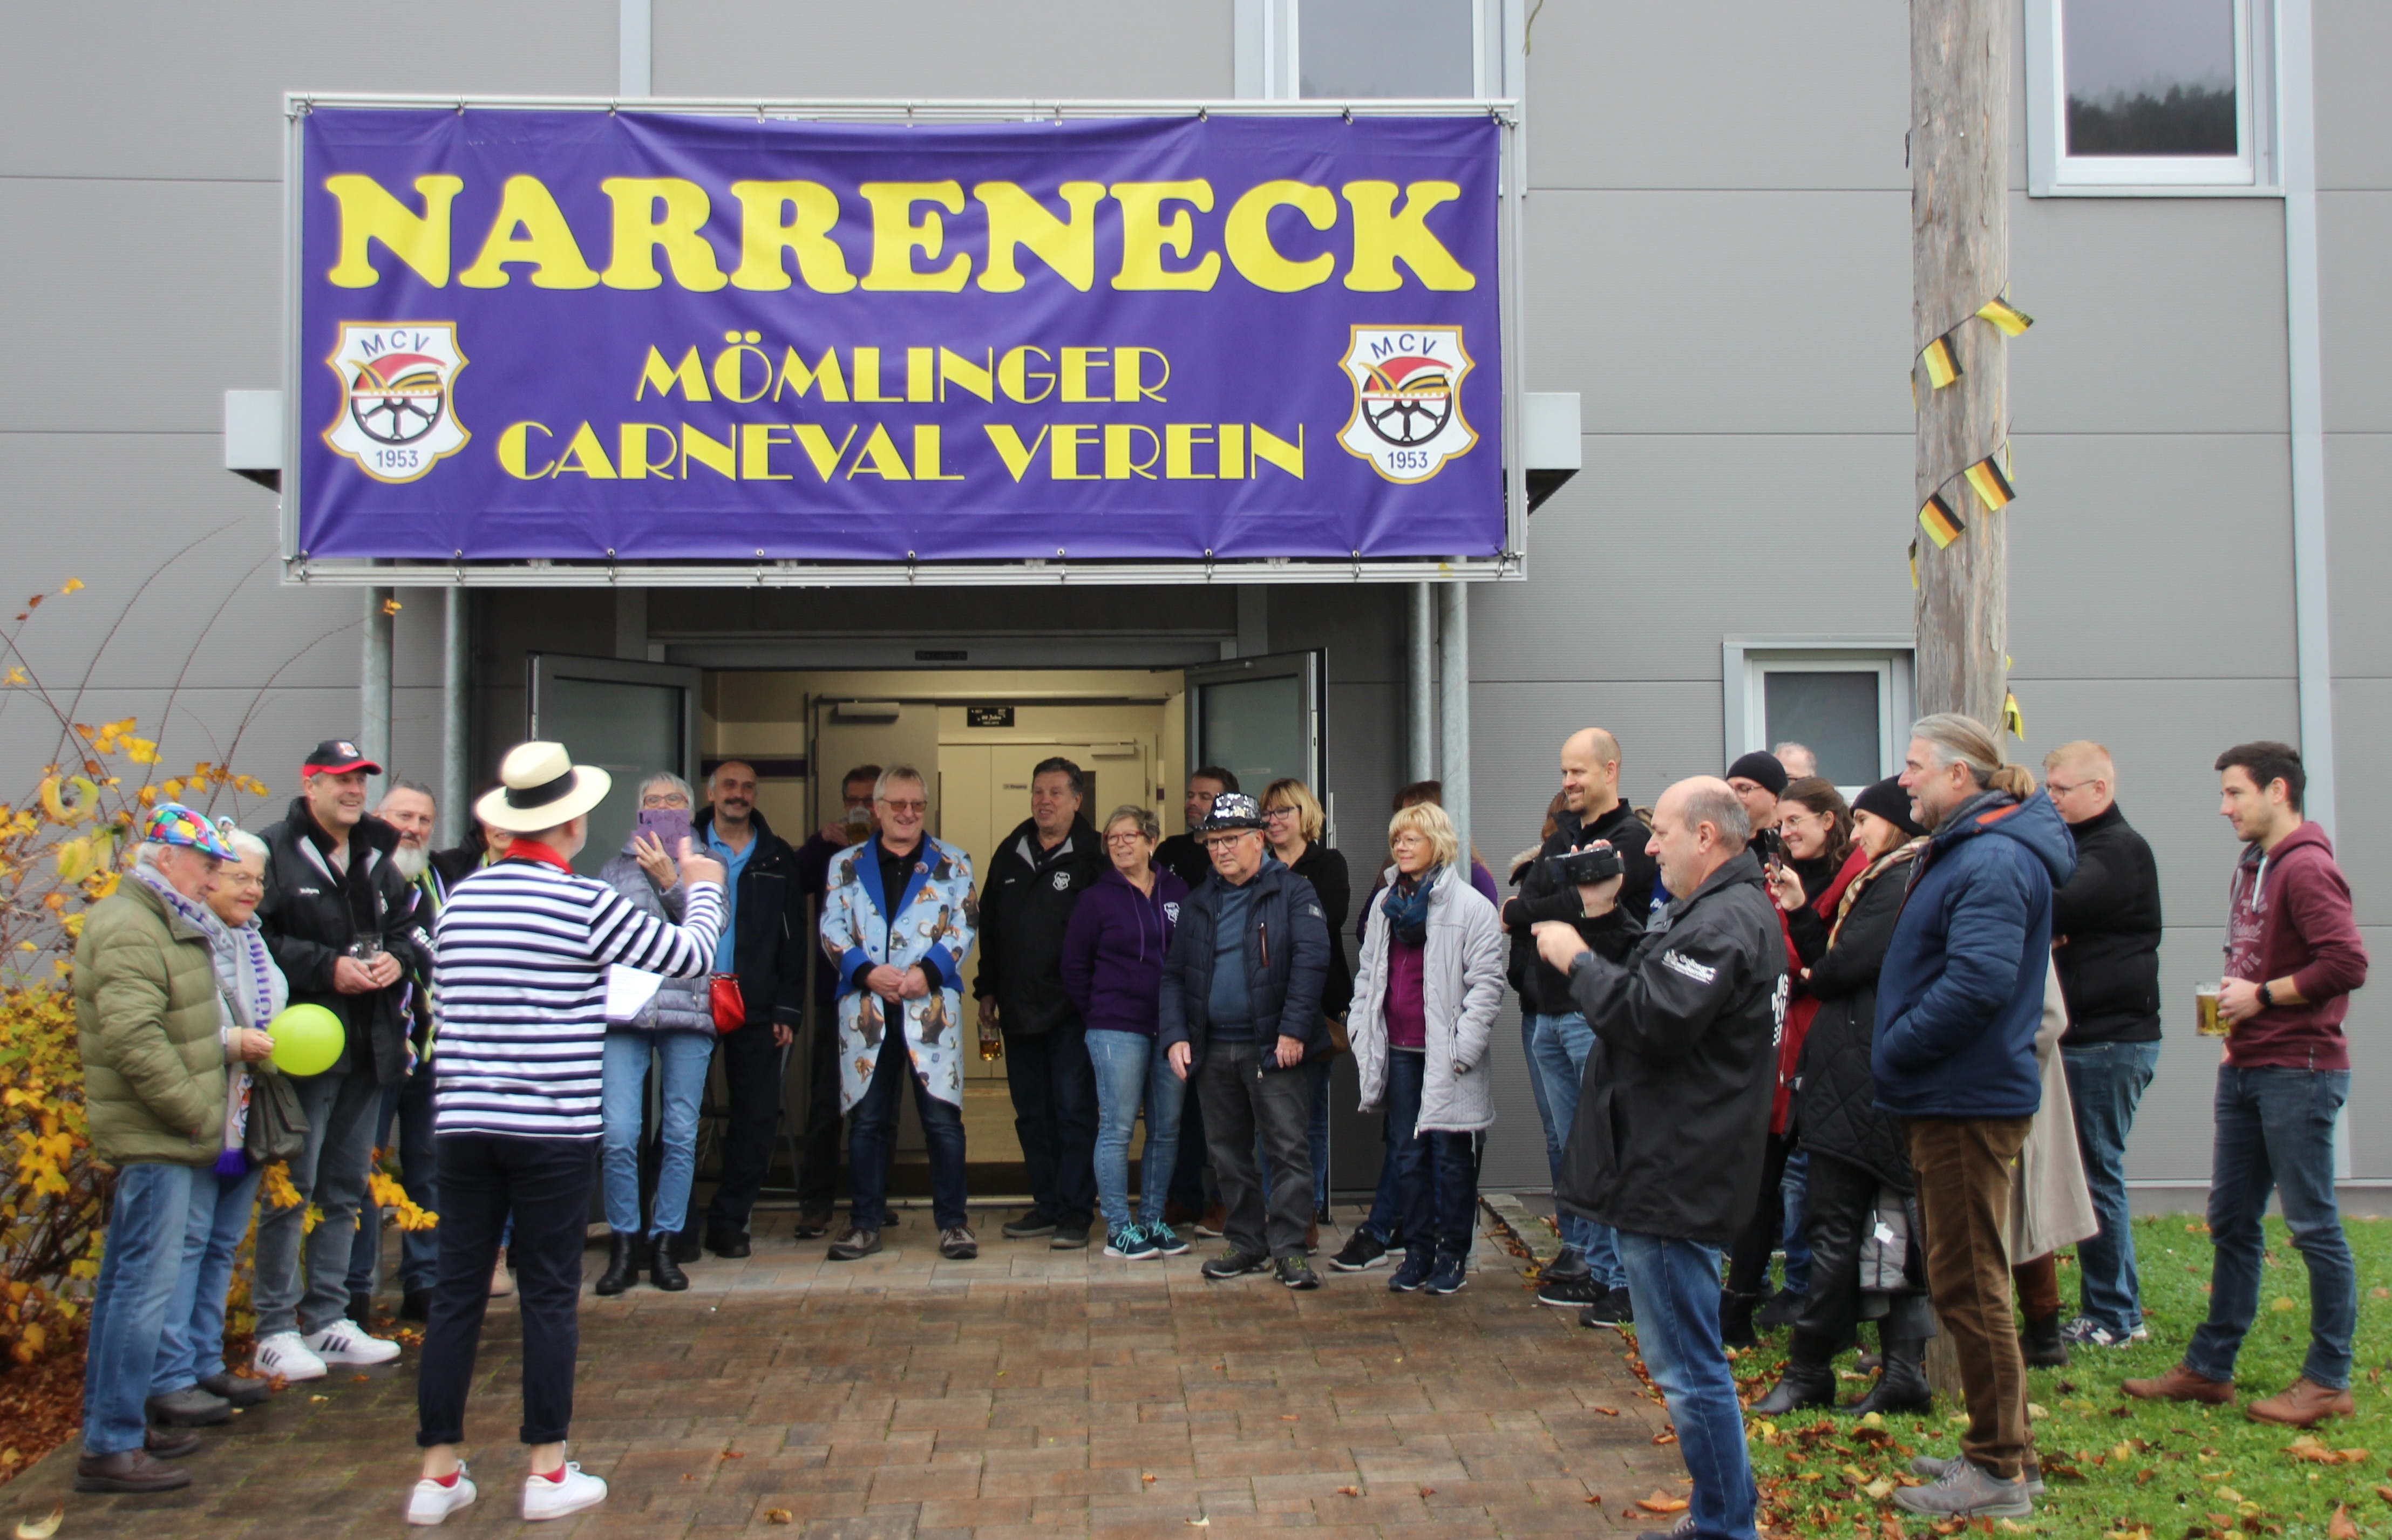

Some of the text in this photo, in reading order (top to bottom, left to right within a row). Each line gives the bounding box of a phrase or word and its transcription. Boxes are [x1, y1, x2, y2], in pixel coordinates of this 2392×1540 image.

[325, 174, 1476, 294] NARRENECK
[361, 330, 431, 358] MCV
[1370, 333, 1437, 359] MCV
[636, 330, 1170, 404] MÖMLINGER
[376, 450, 419, 468] 1953
[497, 420, 1304, 482] CARNEVAL VEREIN
[1388, 451, 1428, 469] 1953
